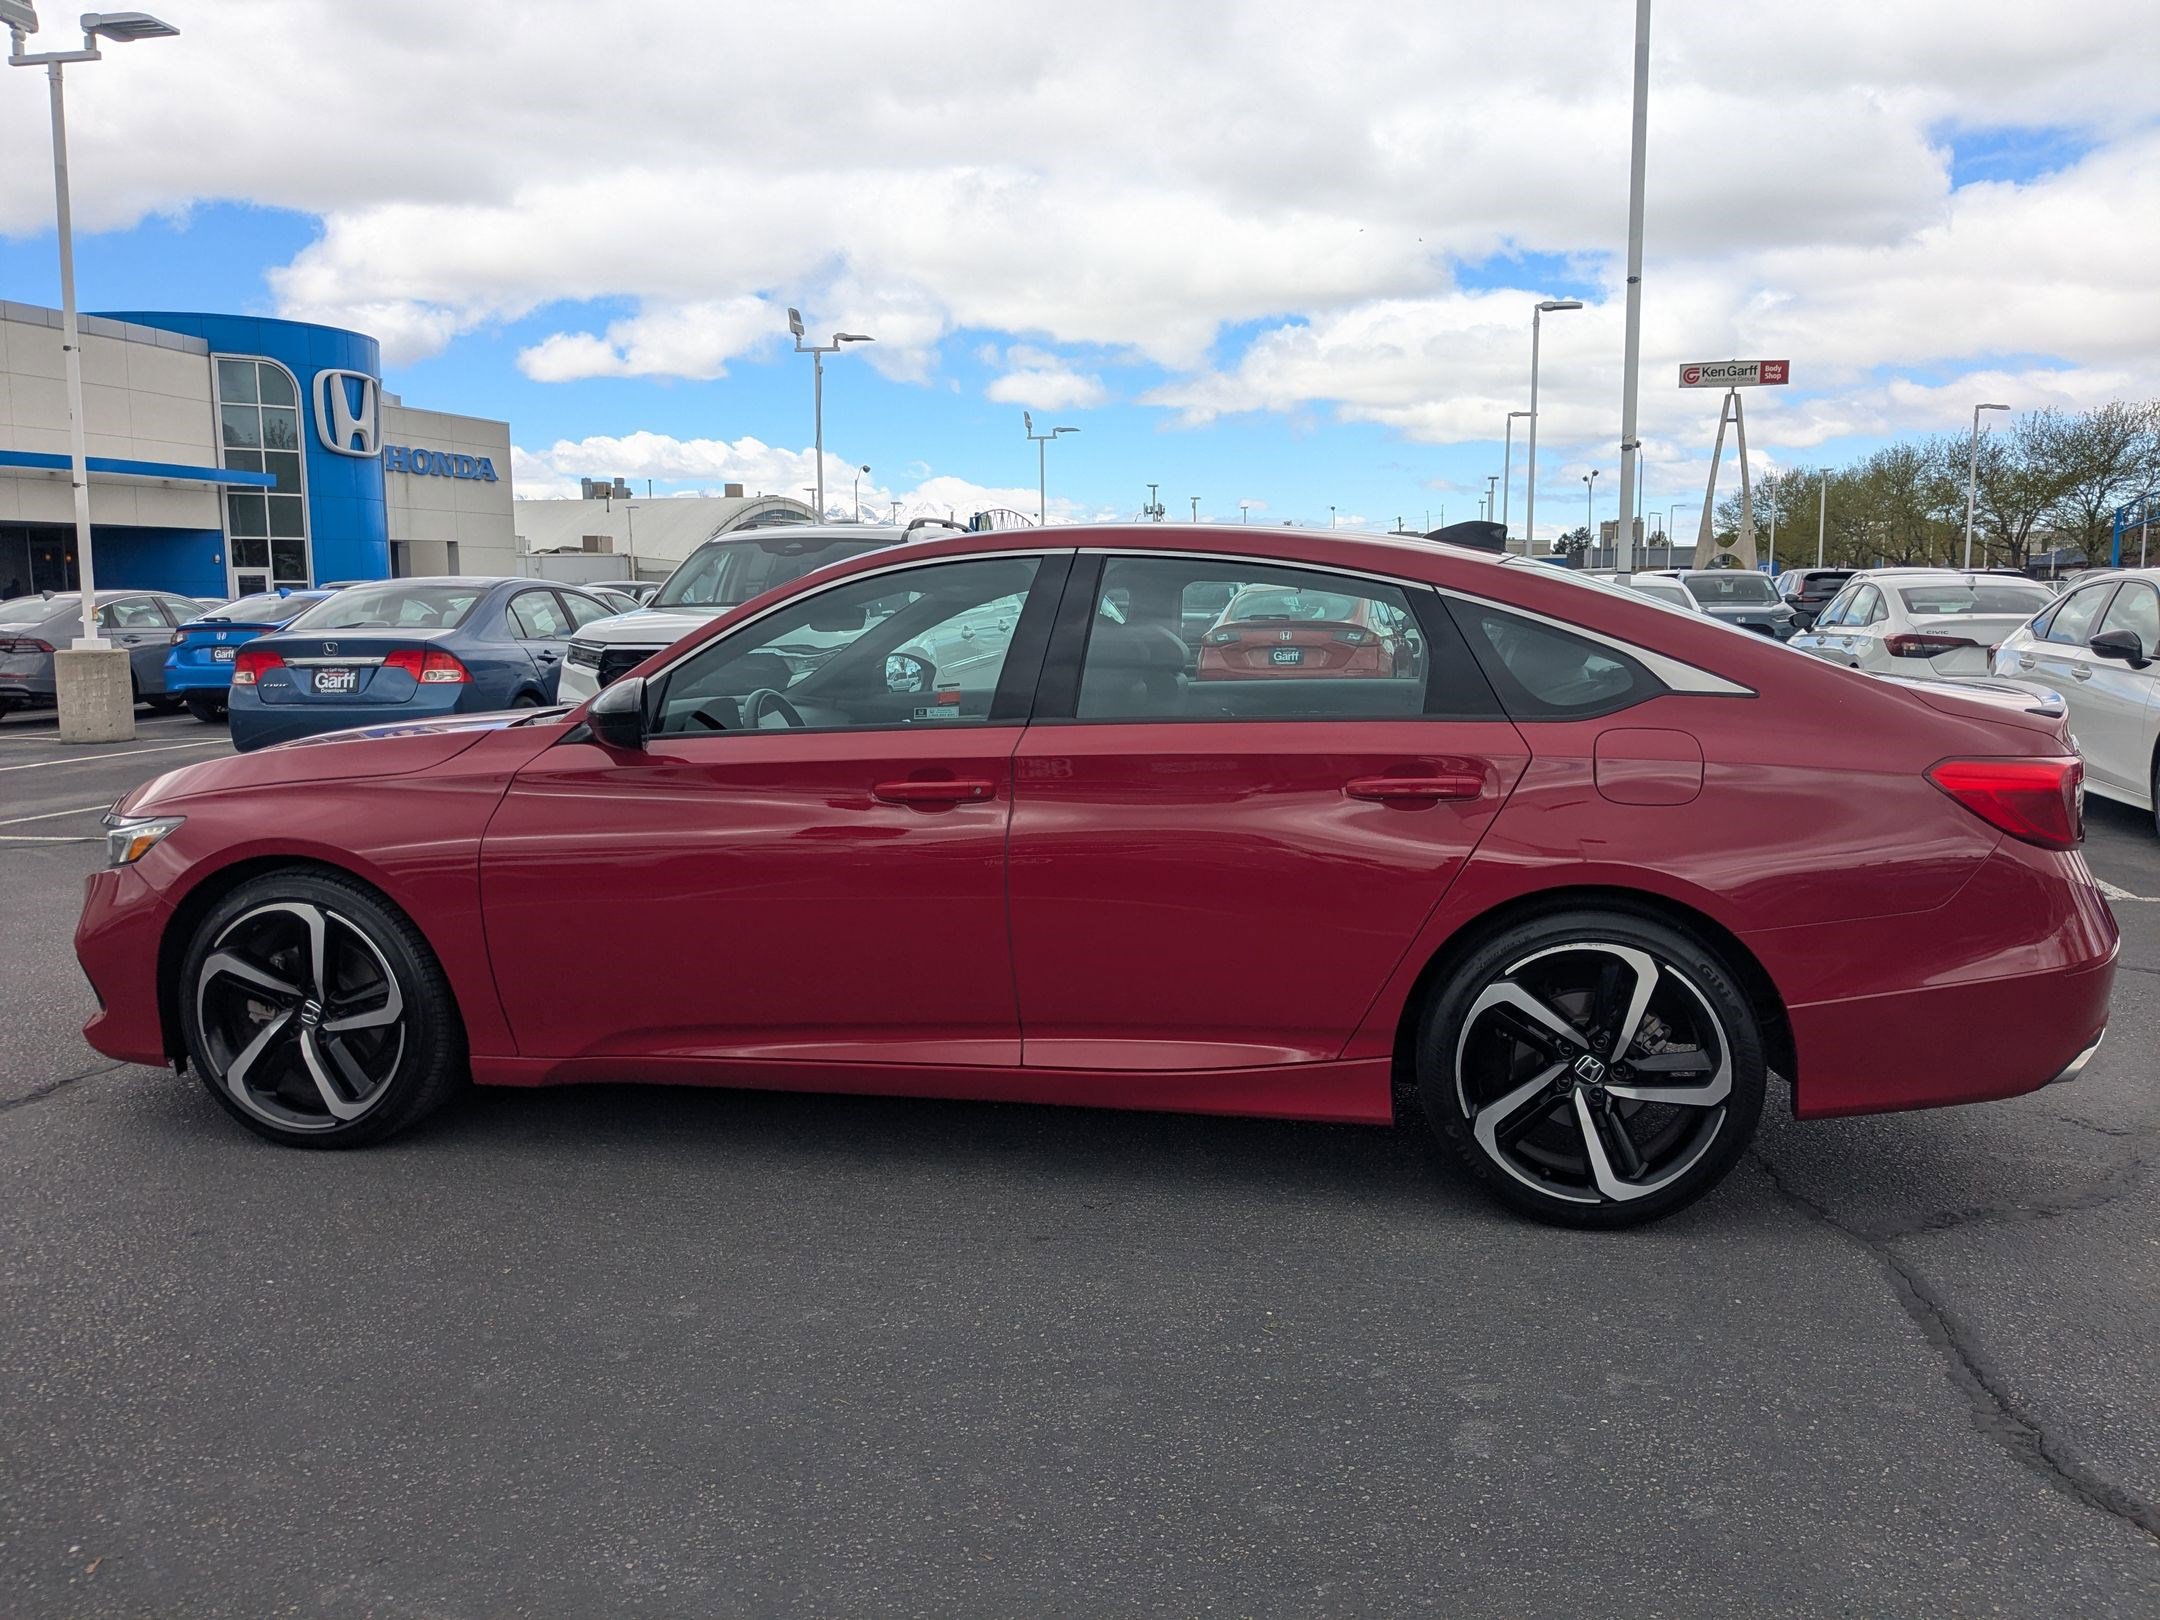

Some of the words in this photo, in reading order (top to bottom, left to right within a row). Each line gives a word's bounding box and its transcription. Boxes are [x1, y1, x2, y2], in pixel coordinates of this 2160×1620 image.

[1702, 366, 1725, 377] Ken
[1727, 365, 1758, 376] Garff
[1765, 364, 1782, 373] Body
[1764, 372, 1782, 380] Shop
[384, 444, 498, 482] HONDA
[214, 650, 234, 658] Garff
[1273, 651, 1299, 661] Garff
[315, 672, 356, 688] Garff
